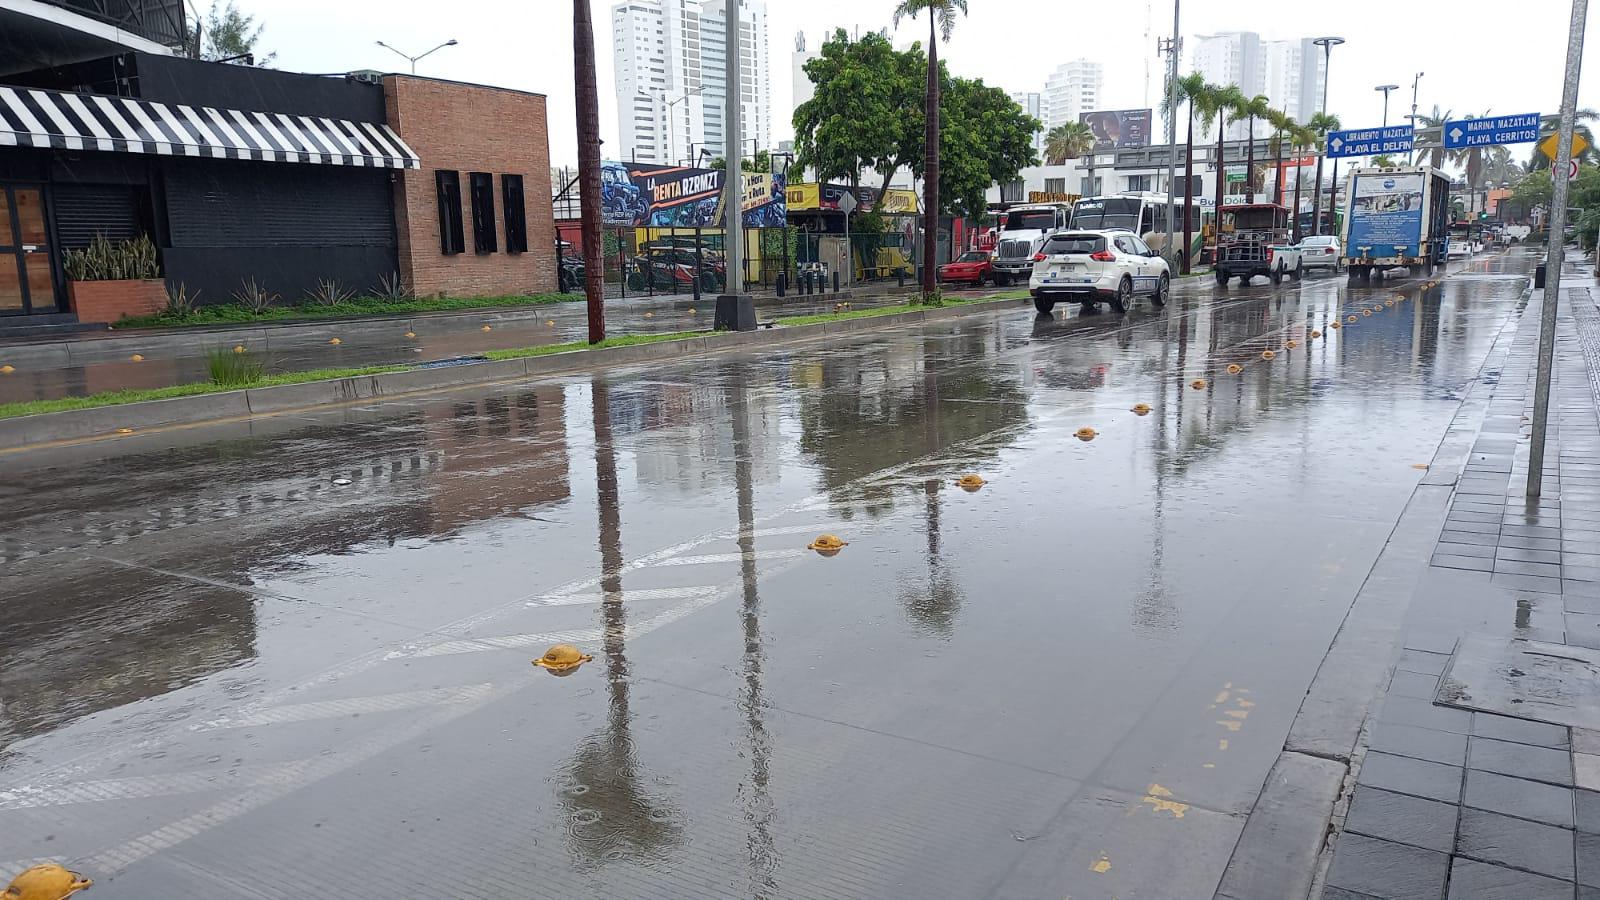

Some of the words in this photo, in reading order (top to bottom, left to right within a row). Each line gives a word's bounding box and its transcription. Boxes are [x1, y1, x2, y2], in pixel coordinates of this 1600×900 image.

[1467, 122, 1495, 133] MARINA
[1497, 116, 1537, 130] MAZATLAN
[1345, 131, 1380, 142] LIBRAMIENTO
[1382, 127, 1413, 139] MAZATLAN
[1466, 134, 1491, 145] PLAYA
[1495, 129, 1537, 142] CERRITOS
[1344, 144, 1370, 155] PLAYA
[1370, 142, 1382, 152] EL
[1383, 140, 1412, 151] DELFIN
[647, 178, 657, 191] LA
[654, 181, 682, 202] RENTA
[682, 171, 719, 196] RZRMZT
